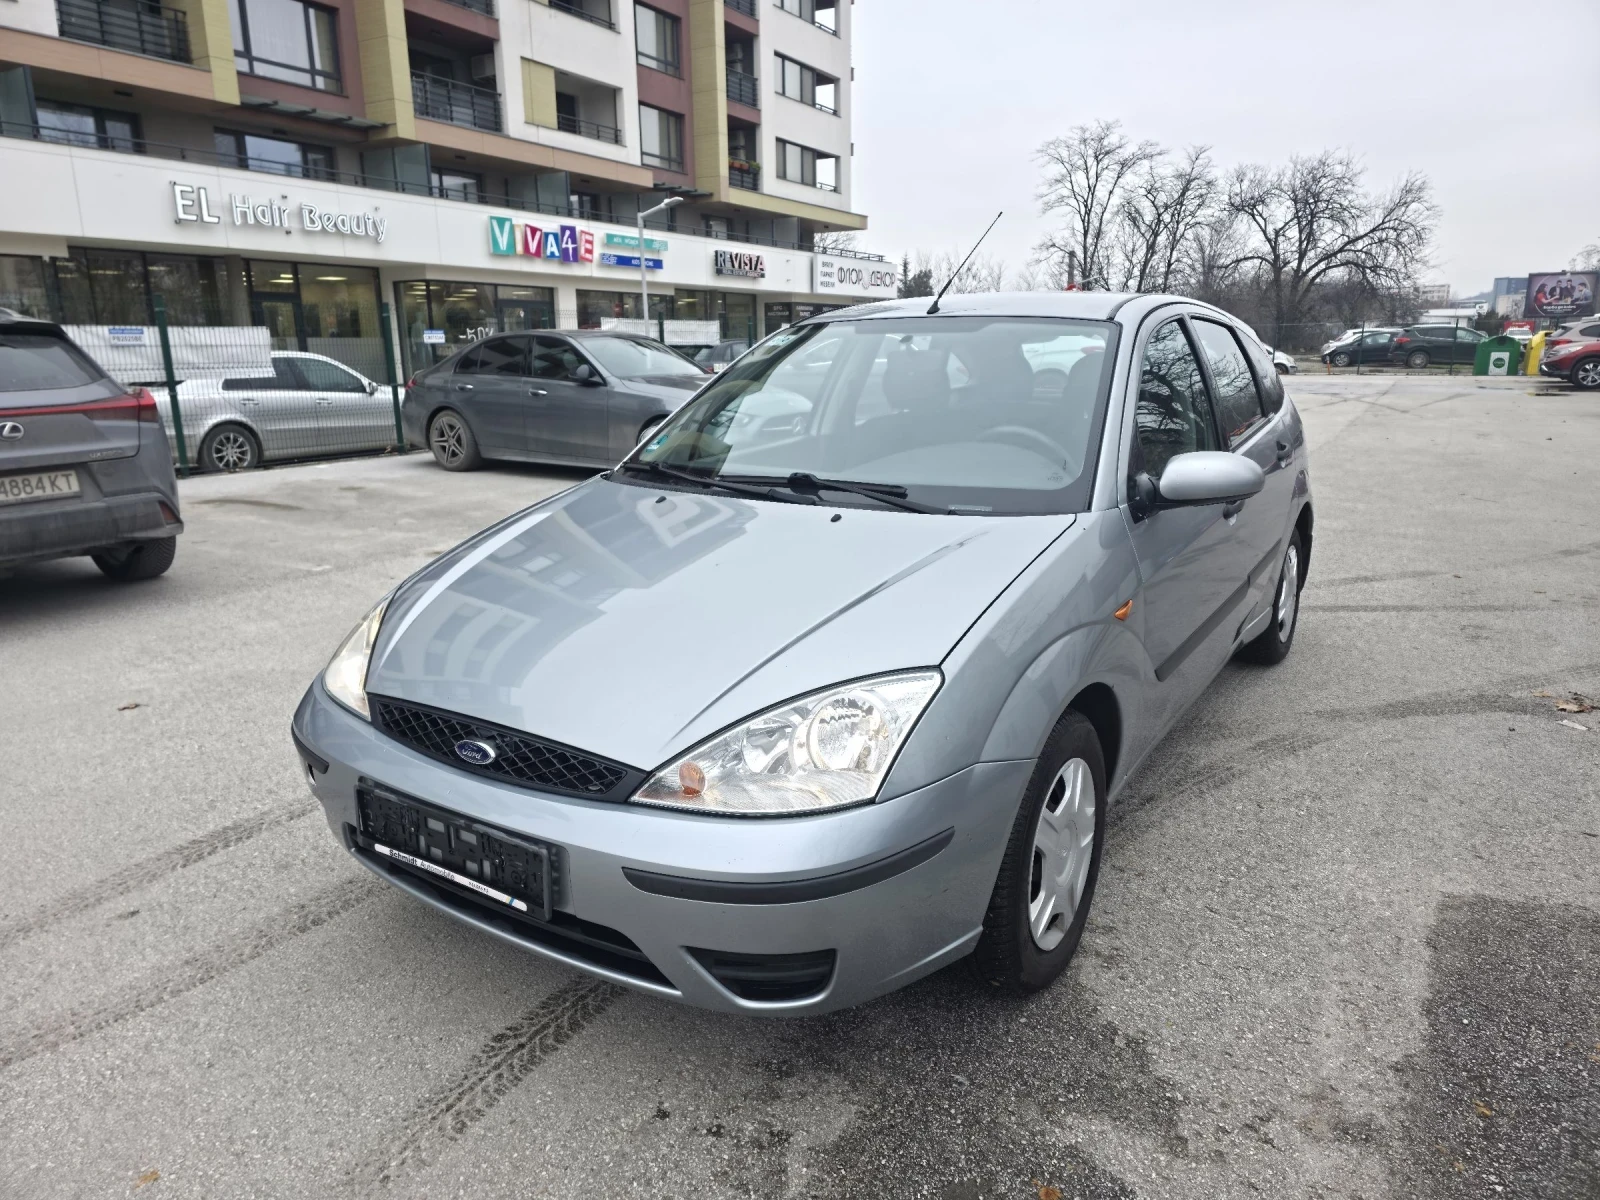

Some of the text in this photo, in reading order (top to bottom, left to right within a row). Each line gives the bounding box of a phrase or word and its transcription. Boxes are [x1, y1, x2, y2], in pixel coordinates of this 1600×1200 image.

[173, 184, 387, 242] EL Hair Beauty
[490, 217, 594, 262] VIVA4E
[715, 250, 766, 271] REVISTA
[837, 267, 896, 288] ФЛОР ДЕКОР
[462, 744, 483, 760] Ford
[389, 849, 456, 881] Schmidt Automobile
